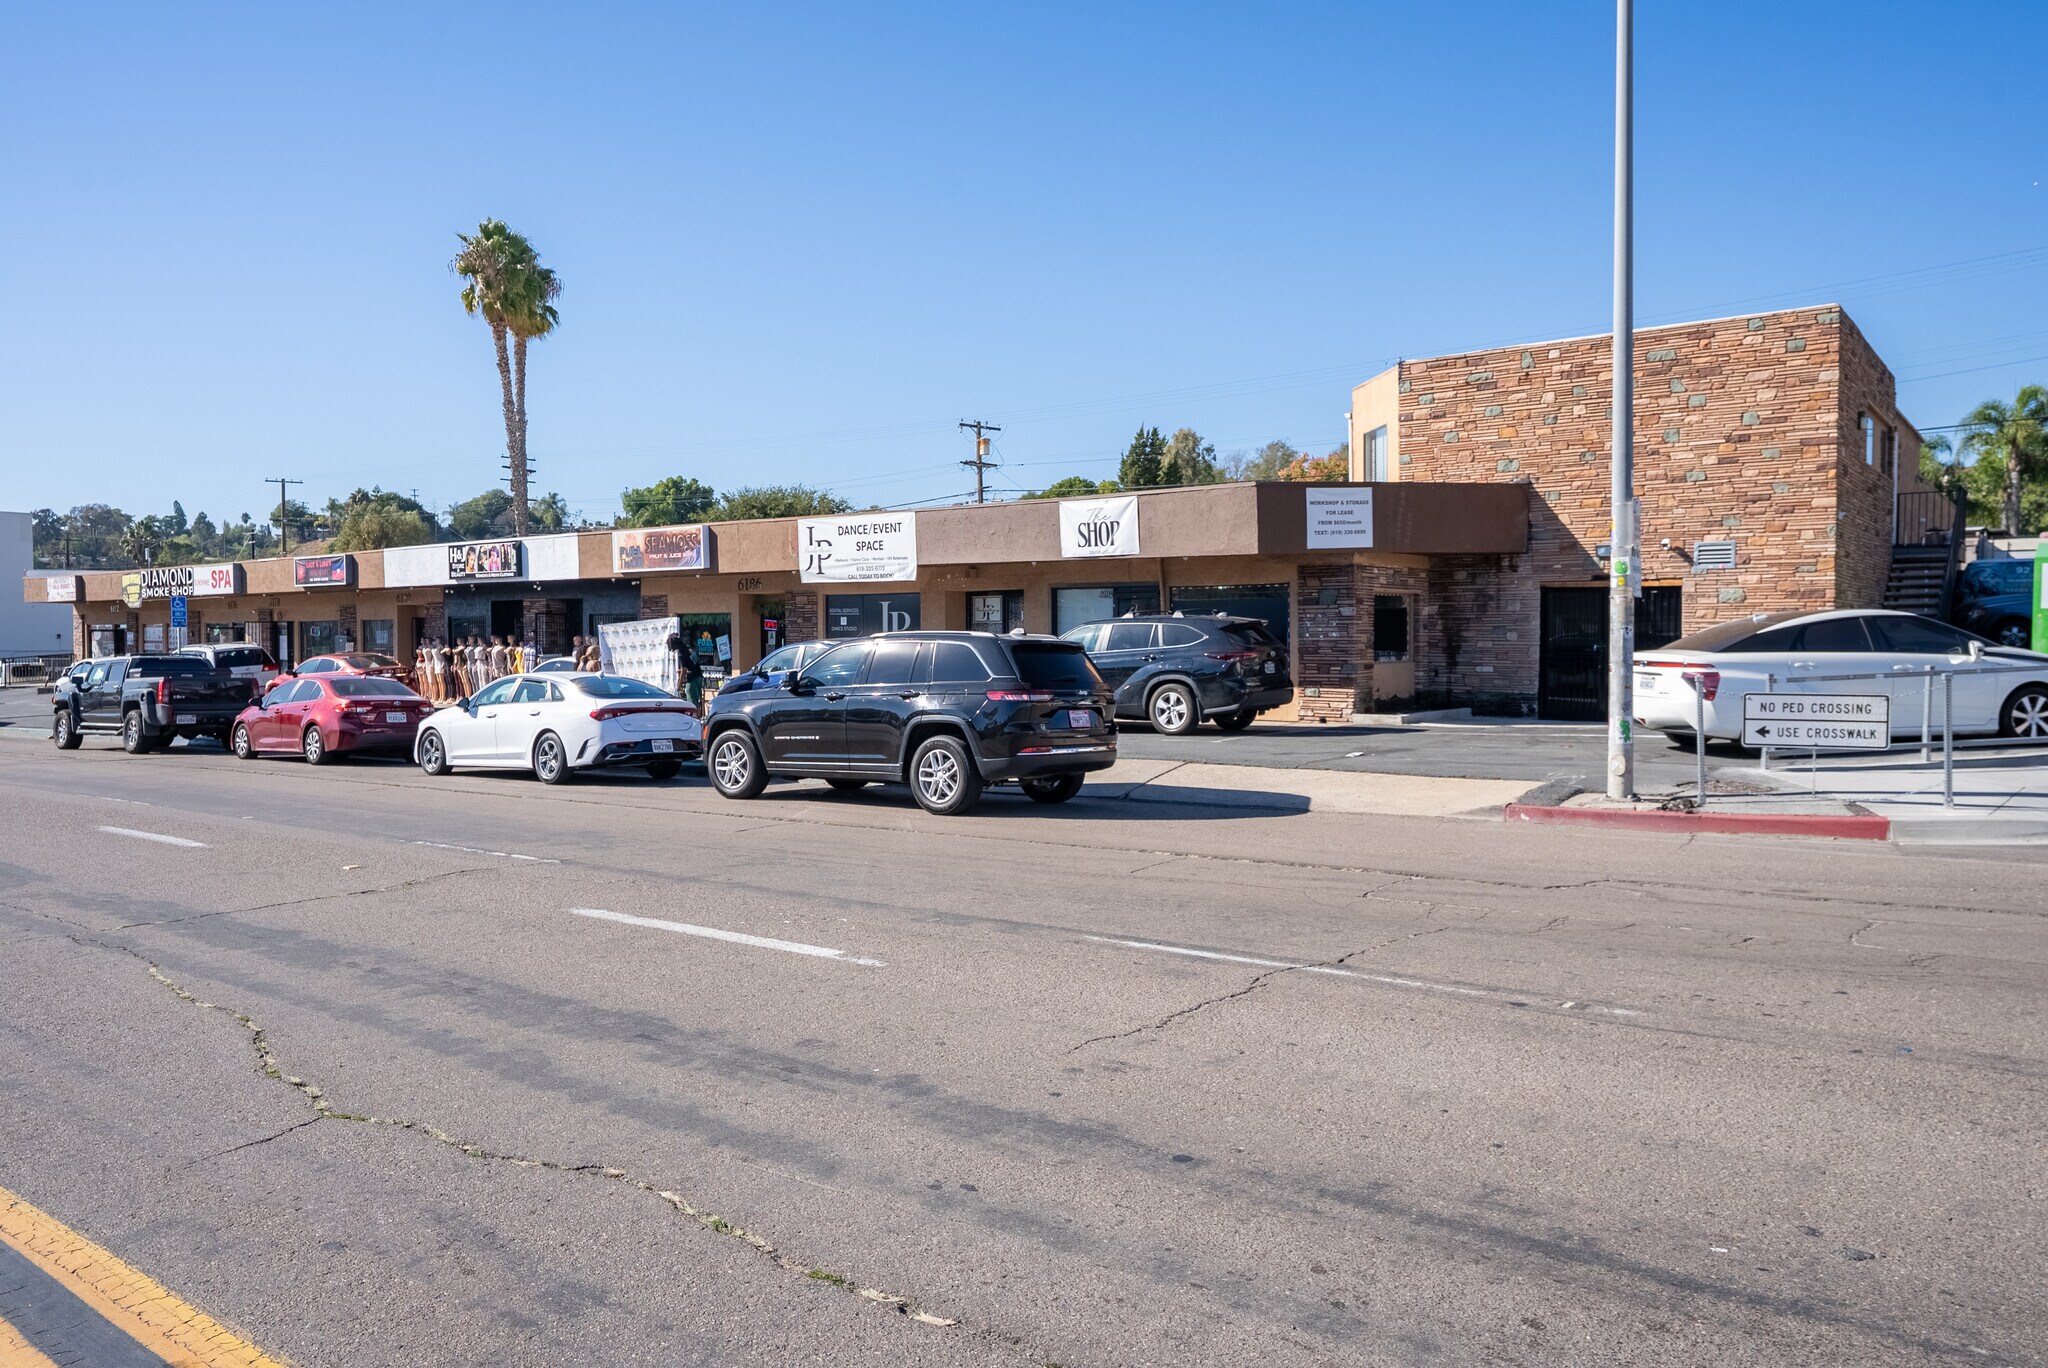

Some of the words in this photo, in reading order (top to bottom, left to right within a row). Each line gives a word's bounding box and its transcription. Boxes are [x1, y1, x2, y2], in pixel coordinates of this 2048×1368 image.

[1086, 500, 1112, 523] The
[837, 522, 903, 536] DANCE/EVENT
[1077, 520, 1120, 548] SHOP
[856, 540, 884, 552] SPACE
[140, 567, 193, 587] DIAMOND
[211, 569, 232, 589] SPA
[738, 577, 762, 591] 6186
[141, 588, 170, 598] SMOKE
[171, 586, 193, 597] SHOP
[697, 638, 714, 647] FUEL
[1760, 702, 1775, 713] NO
[1782, 702, 1804, 713] PED
[1811, 703, 1872, 714] CROSSING
[1777, 727, 1800, 738] USE
[1806, 728, 1876, 739] CROSSWALK
